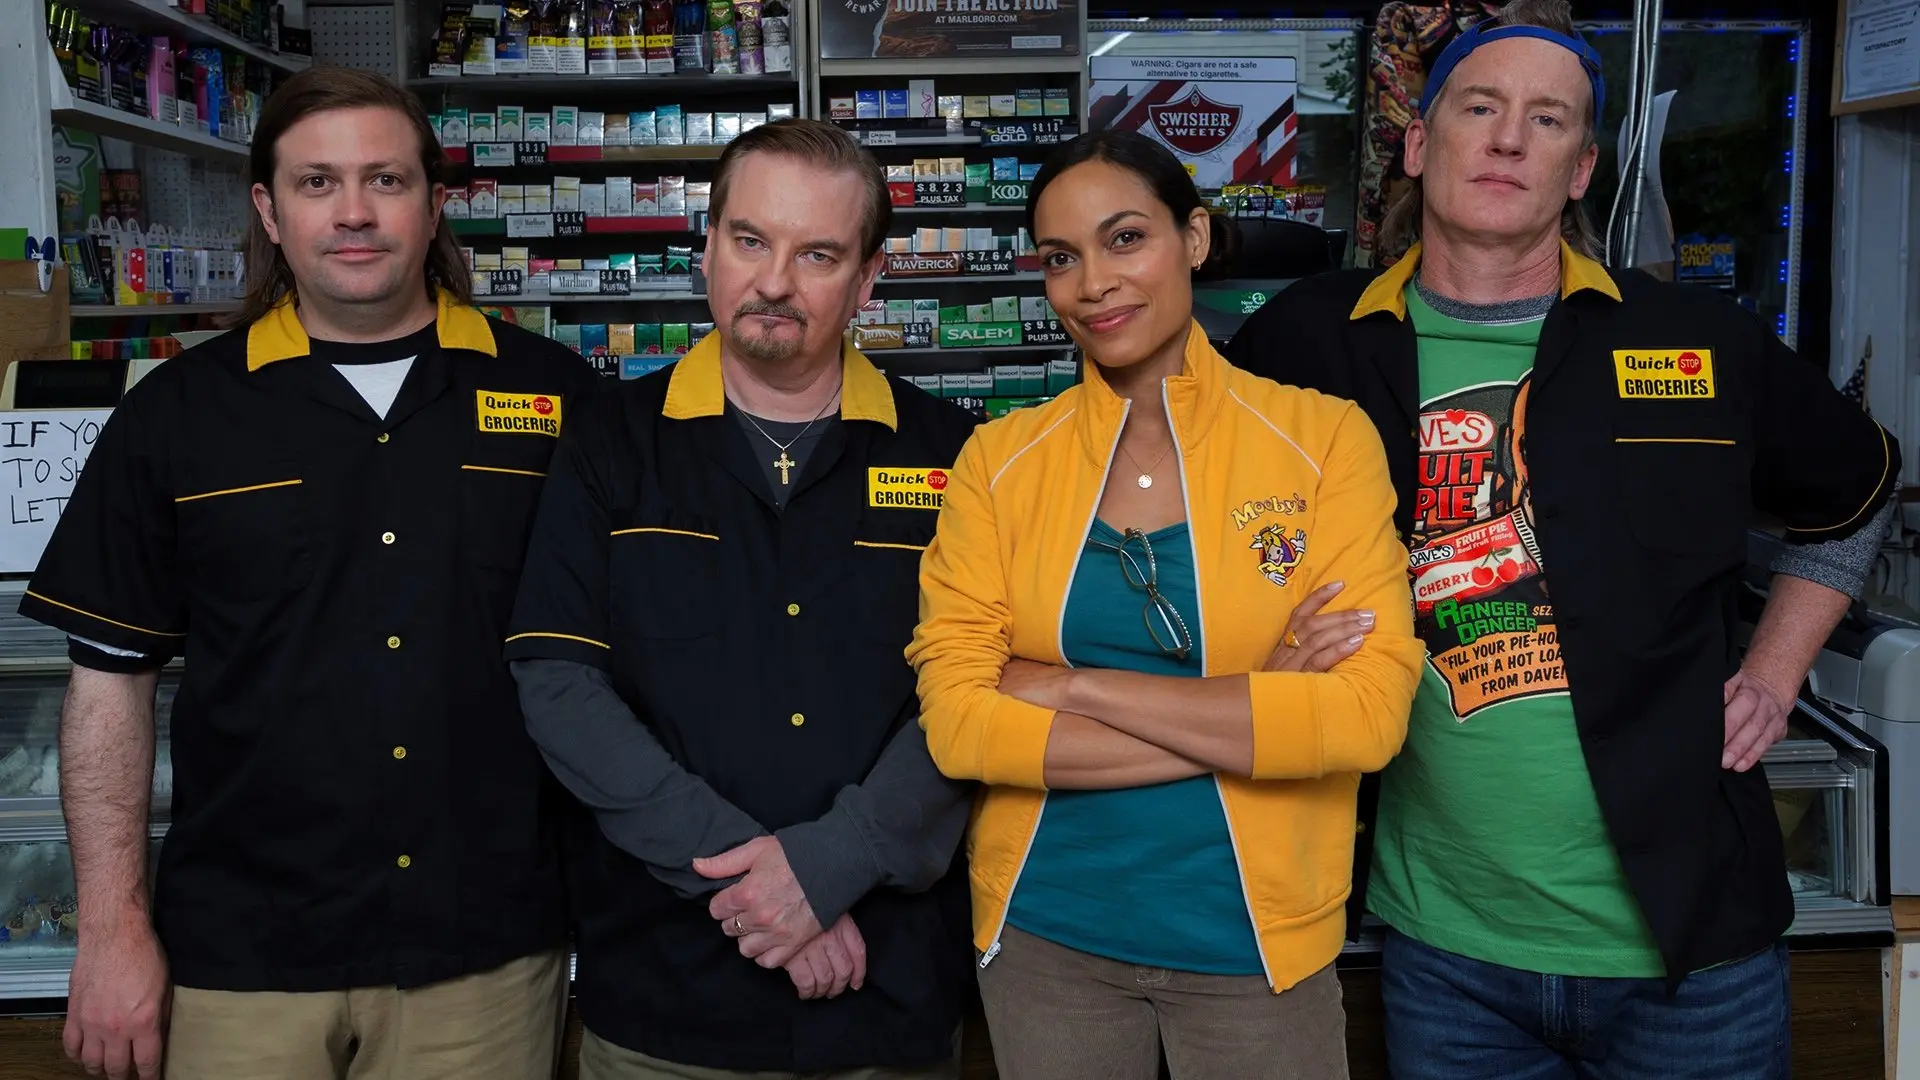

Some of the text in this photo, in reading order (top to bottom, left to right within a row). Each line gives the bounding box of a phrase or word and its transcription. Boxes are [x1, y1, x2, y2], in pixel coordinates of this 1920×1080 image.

[895, 0, 937, 12] JOIN
[985, 0, 1059, 12] ACTION
[935, 15, 1018, 24] AT MARLBORO.COM
[1131, 60, 1174, 68] WARNING:
[1176, 60, 1202, 69] Cigars
[1240, 60, 1258, 68] safe
[1200, 70, 1243, 79] cigarettes.
[1159, 111, 1232, 128] SWISHER
[997, 126, 1026, 134] USA
[1165, 128, 1226, 137] SWEETS
[991, 134, 1028, 142] GOLD
[1035, 135, 1048, 143] PLUS
[521, 156, 534, 164] PLUS
[991, 185, 1028, 199] KOOL
[920, 195, 941, 203] PLUS
[559, 226, 572, 234] PLUS
[892, 259, 954, 271] MAVERICK
[970, 263, 1009, 271] PLUS TAX
[495, 283, 507, 292] PLUS
[558, 275, 593, 288] Marlboro
[603, 283, 615, 291] PLUS
[947, 327, 1013, 340] SALEM
[1028, 333, 1066, 342] PLUS TAX
[1053, 364, 1075, 372] Newport
[1625, 355, 1699, 370] Quick STOP
[1625, 379, 1708, 395] GROCERIES
[485, 396, 552, 410] Quick STOP
[484, 415, 557, 434] GROCERIES
[1, 418, 105, 452] IF YO
[2, 458, 51, 488] TO
[877, 472, 946, 485] Quick STOP
[1413, 485, 1477, 519] PIE
[1231, 493, 1308, 531] Mooby's
[1455, 522, 1508, 548] FRUIT PIE
[1419, 571, 1471, 598] CHERRY
[1434, 597, 1529, 630] RANGER
[1457, 616, 1537, 645] DANGER
[1441, 650, 1470, 670] "FILL
[1472, 639, 1506, 659] YOUR
[1458, 661, 1489, 685] WITH
[1494, 658, 1504, 673] A
[1508, 651, 1534, 670] HOT
[1481, 664, 1566, 696] FROM DAVE!
